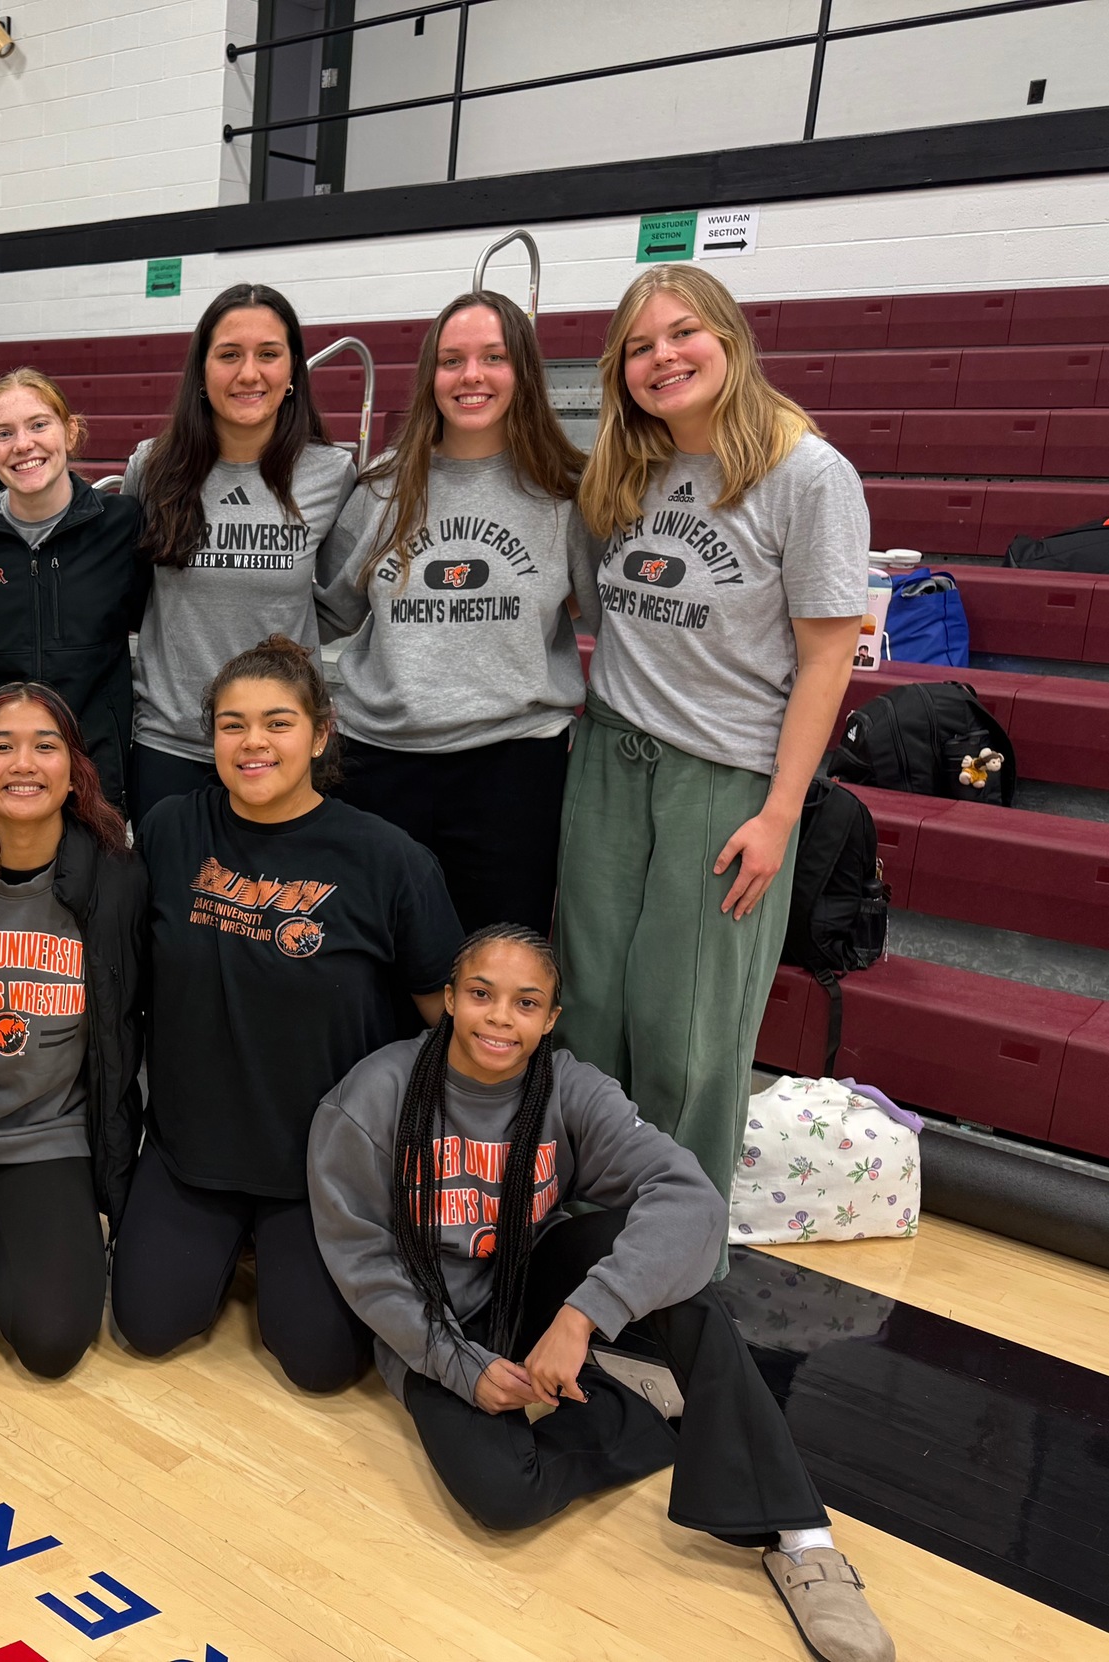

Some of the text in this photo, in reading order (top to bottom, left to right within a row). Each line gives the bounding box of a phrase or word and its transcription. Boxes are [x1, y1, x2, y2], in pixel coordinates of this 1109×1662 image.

[642, 220, 693, 230] WWU STUDENT
[708, 214, 750, 224] WWU FAN
[651, 232, 681, 240] SECTION
[708, 228, 746, 238] SECTION
[667, 494, 695, 503] adidas
[217, 522, 311, 551] UNIVERSITY
[440, 516, 538, 577] UNIVERSITY
[652, 510, 744, 585] UNIVERSITY
[187, 553, 293, 569] OMEN'S WRESTLING
[391, 596, 520, 623] WOMEN'S WRESTLING
[597, 582, 710, 629] OMEN'S WRESTLING
[214, 902, 264, 926] NIVERSITY
[220, 918, 272, 942] WRESTLING
